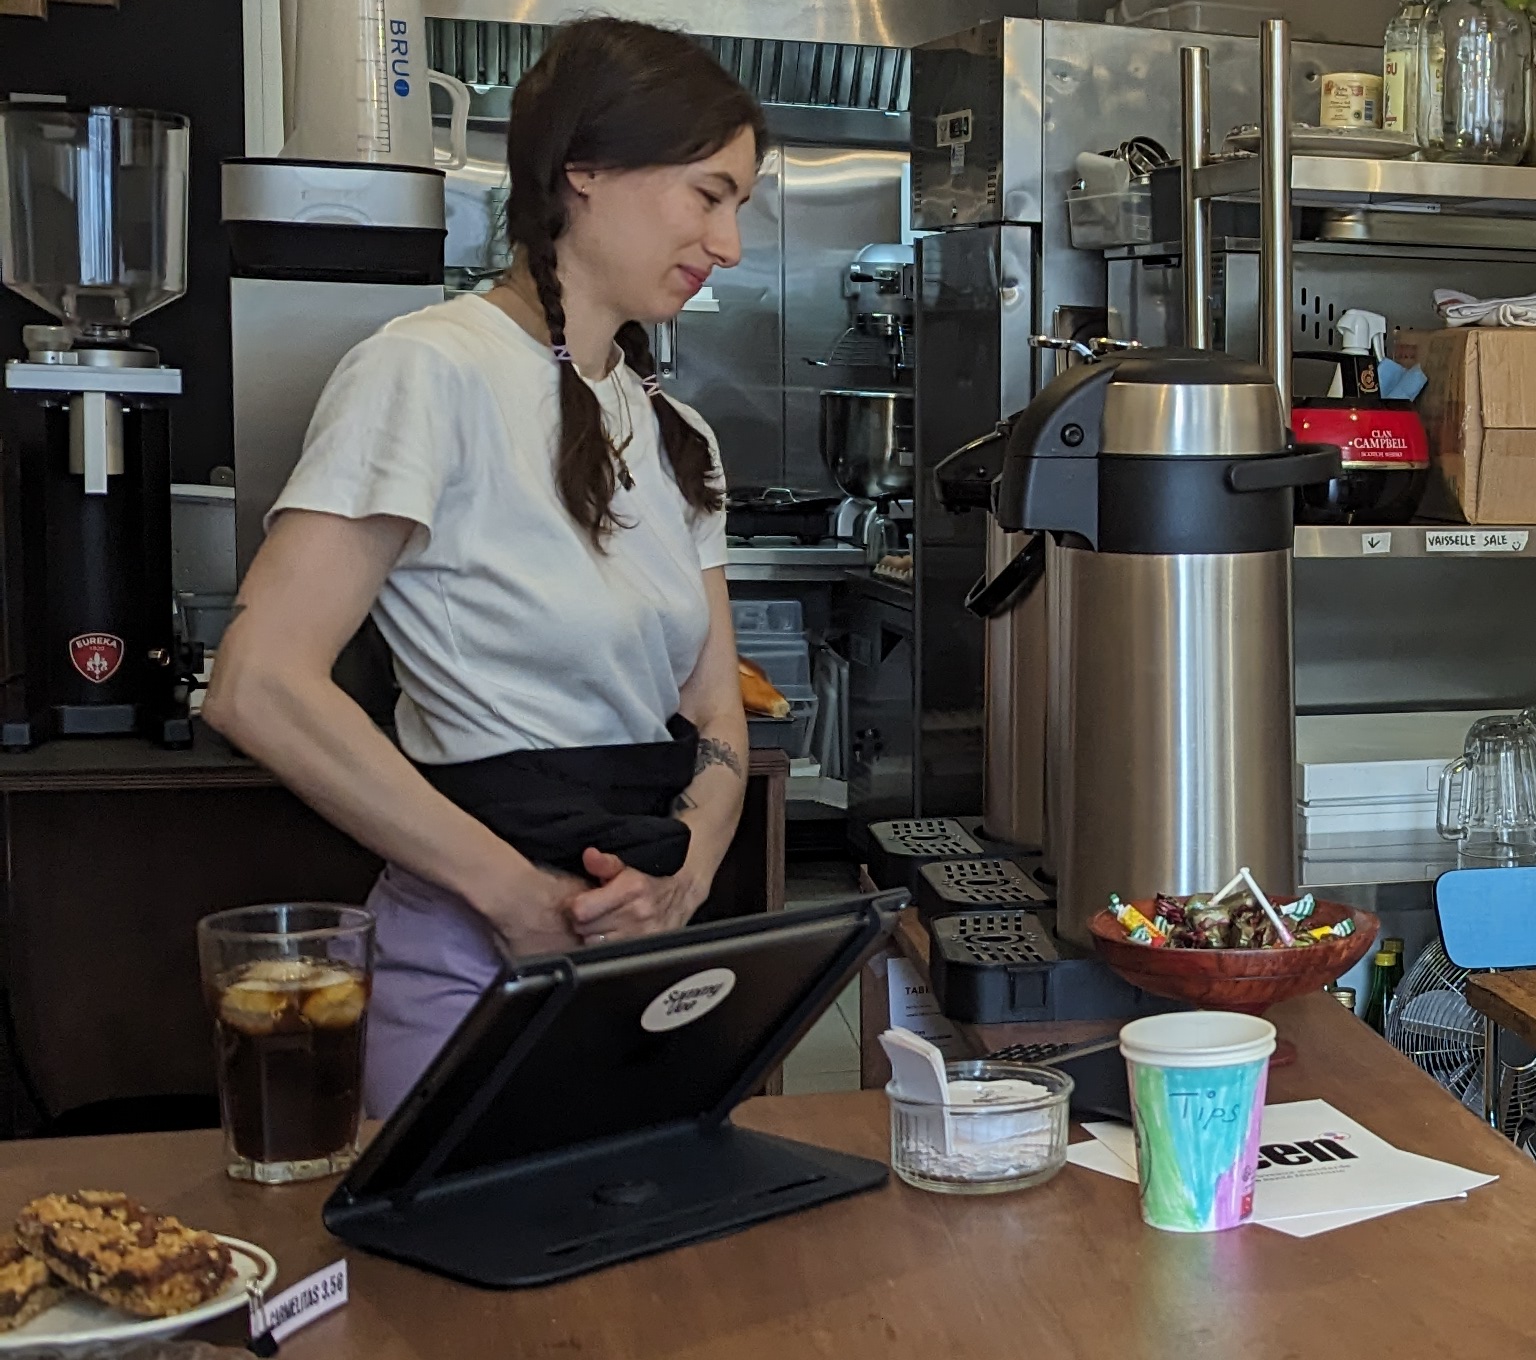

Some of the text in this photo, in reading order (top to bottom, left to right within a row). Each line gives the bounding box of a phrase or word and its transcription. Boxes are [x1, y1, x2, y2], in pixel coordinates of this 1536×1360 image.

[1371, 429, 1393, 438] CLAN
[1353, 437, 1408, 449] CAMPBELL
[1428, 533, 1509, 547] VAISSELLE SALE
[76, 637, 118, 649] EUREKA
[1168, 1090, 1240, 1130] Tips
